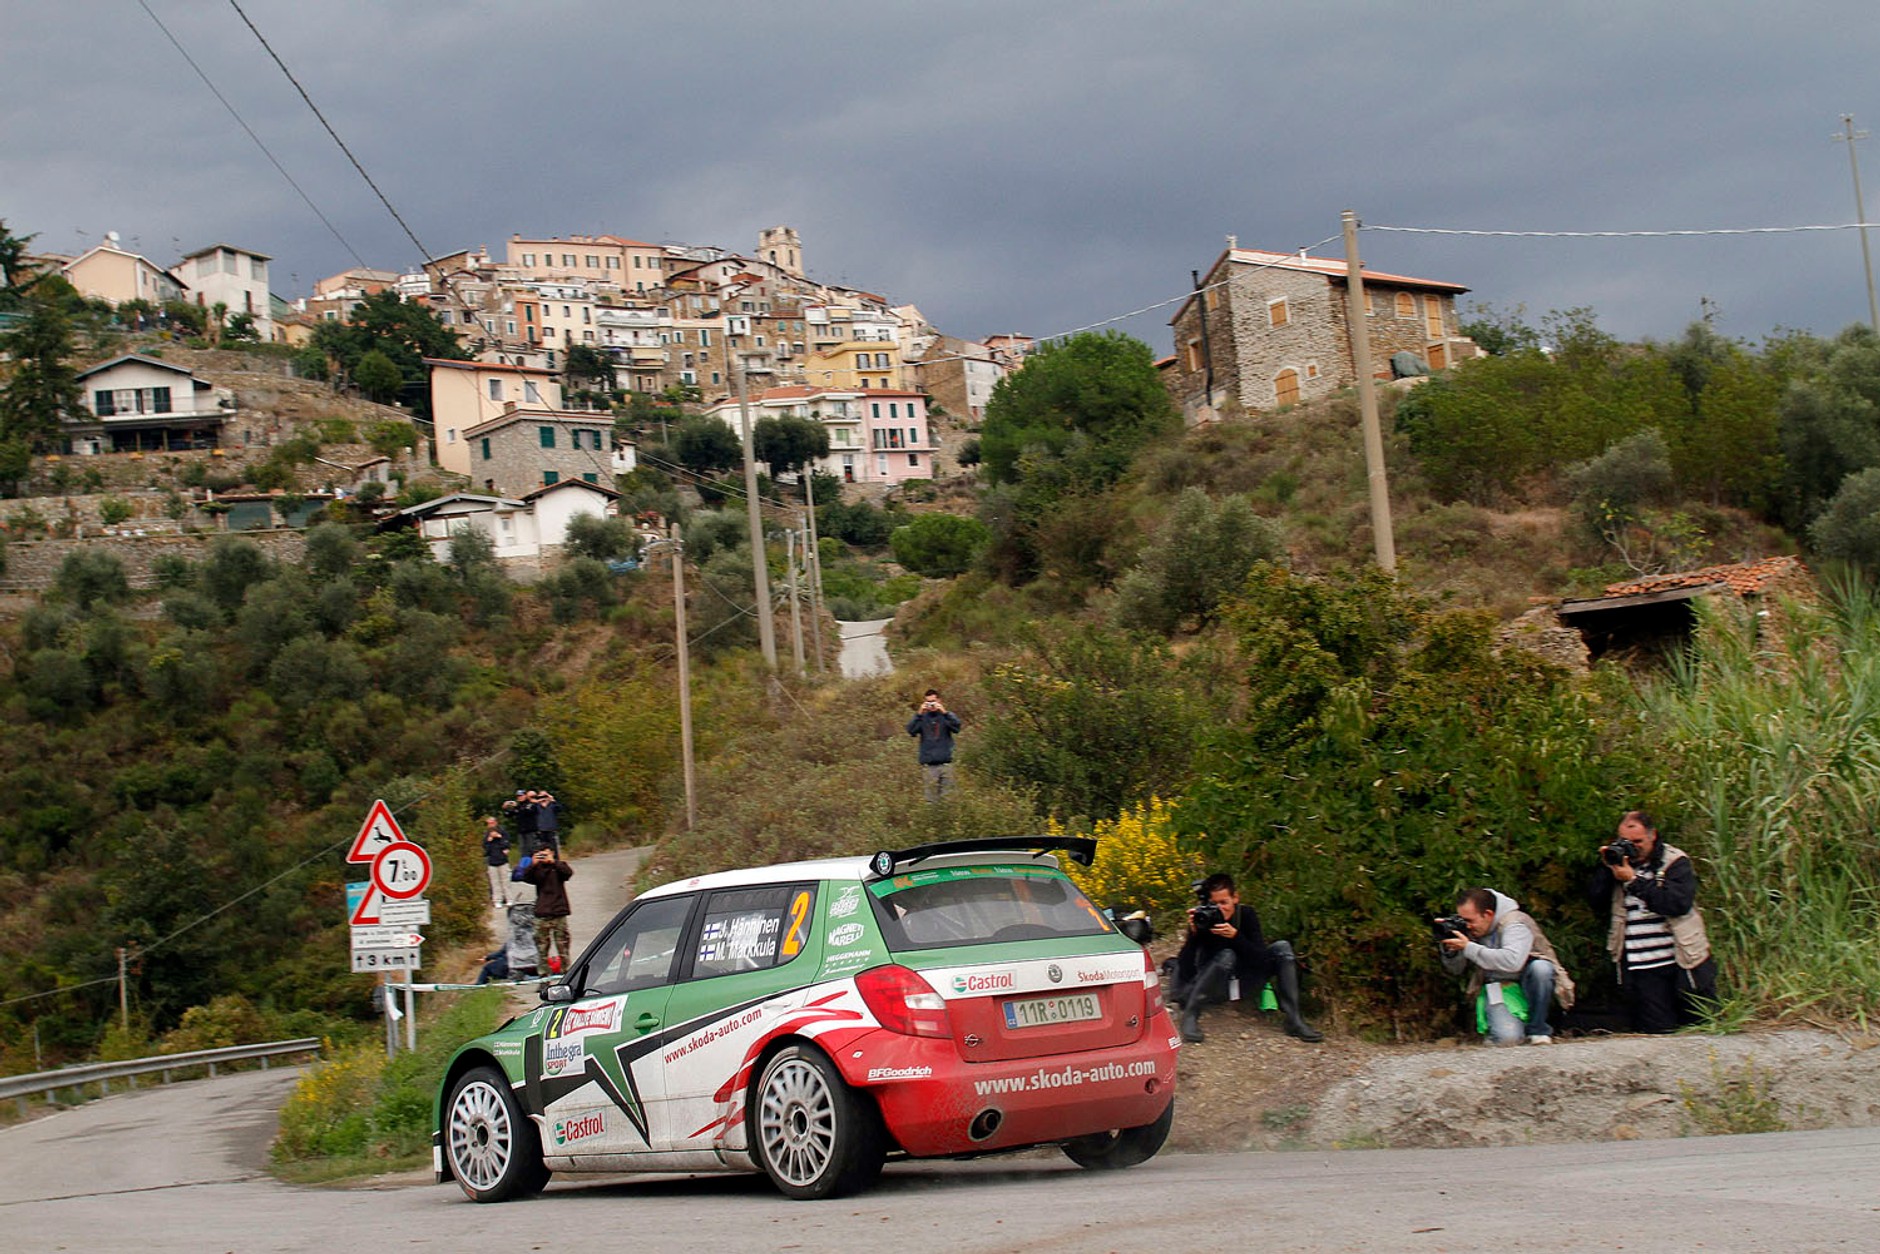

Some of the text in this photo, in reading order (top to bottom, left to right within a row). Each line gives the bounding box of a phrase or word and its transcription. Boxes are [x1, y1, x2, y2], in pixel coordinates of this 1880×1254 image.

[782, 891, 810, 955] 2
[367, 954, 405, 967] 3 km
[968, 974, 1013, 991] Castrol
[550, 1009, 563, 1039] 2
[1019, 1002, 1049, 1024] 11R
[1057, 996, 1095, 1019] 0119
[664, 1008, 763, 1064] www.skoda-auto.com
[547, 1059, 568, 1070] SPORT
[868, 1066, 933, 1078] BFGoodrich
[974, 1060, 1156, 1096] www.skoda-auto.com
[566, 1112, 605, 1142] Castrol
